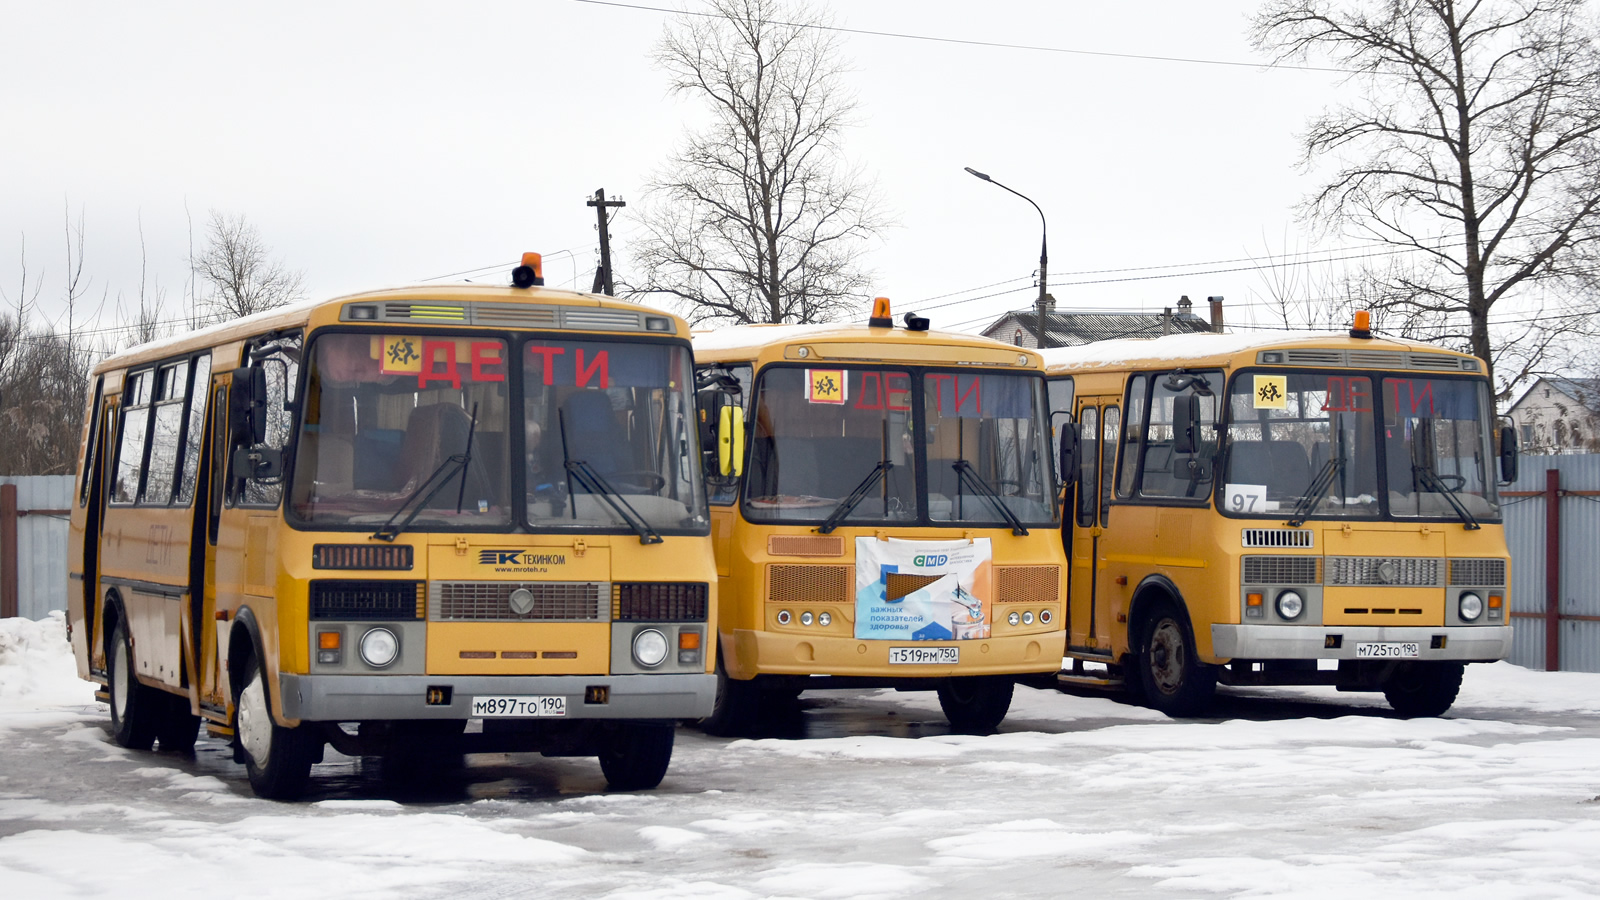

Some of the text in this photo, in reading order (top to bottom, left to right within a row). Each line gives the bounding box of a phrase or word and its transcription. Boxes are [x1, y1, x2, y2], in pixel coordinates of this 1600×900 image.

[1232, 494, 1258, 513] 97
[523, 554, 565, 565] ТЕХИНКОМ
[914, 556, 947, 566] CMD
[870, 623, 909, 631] здоровья
[939, 648, 956, 658] 750
[1402, 644, 1417, 653] 190
[541, 698, 562, 709] 190
